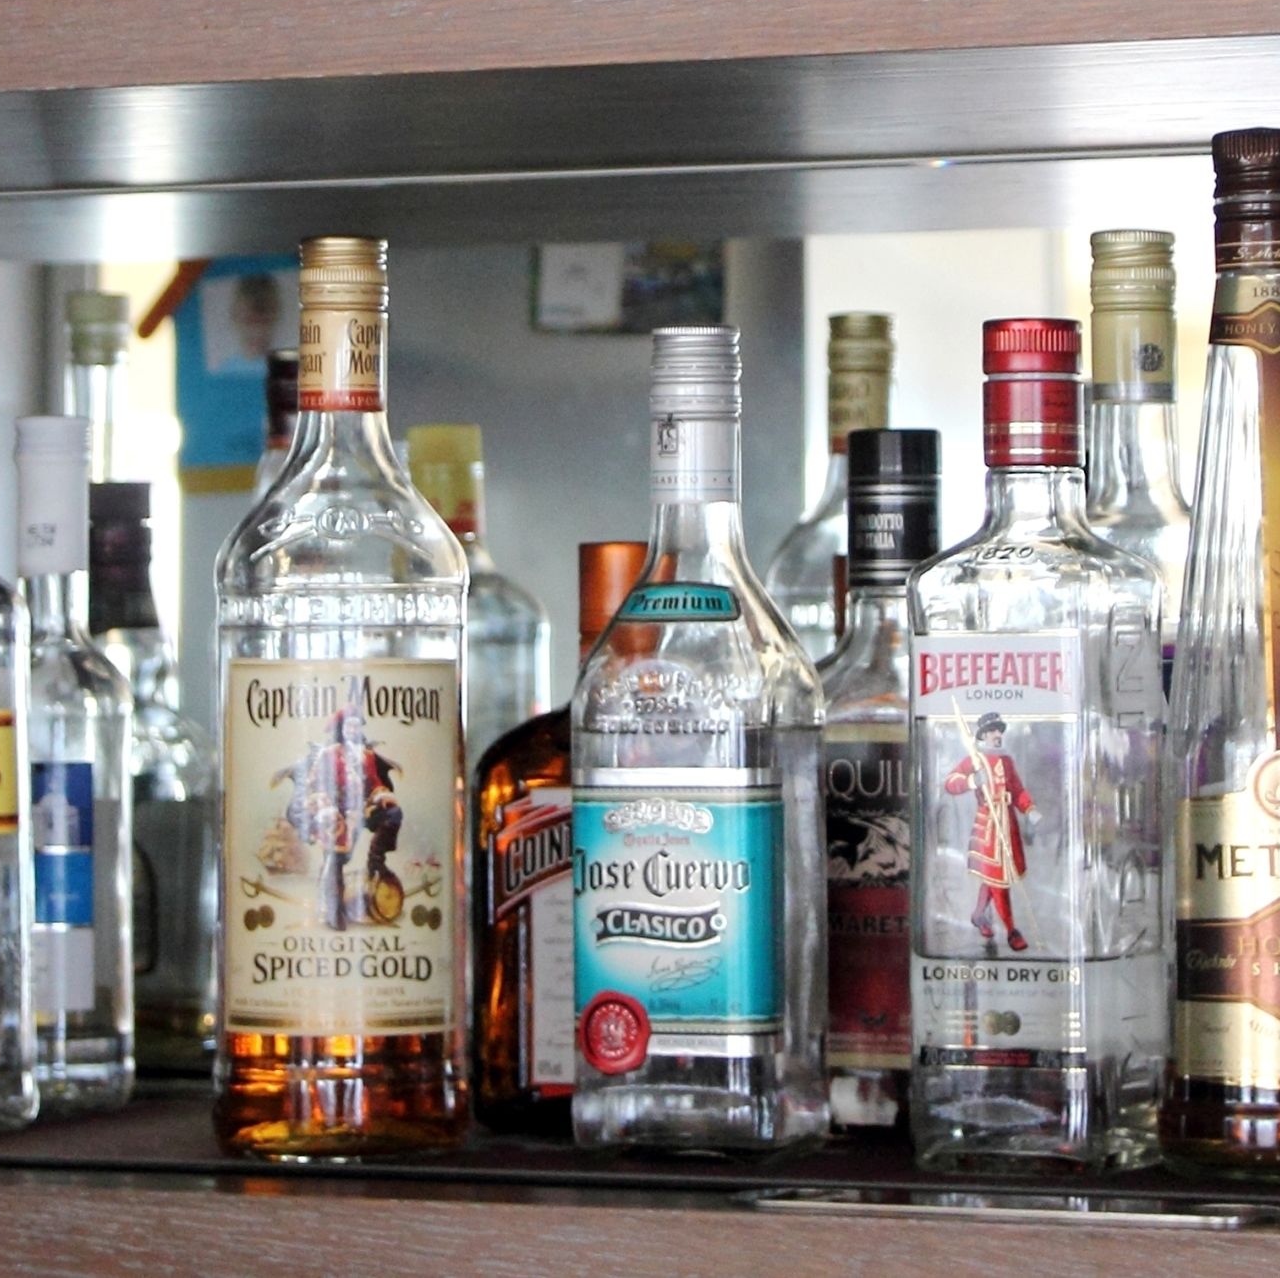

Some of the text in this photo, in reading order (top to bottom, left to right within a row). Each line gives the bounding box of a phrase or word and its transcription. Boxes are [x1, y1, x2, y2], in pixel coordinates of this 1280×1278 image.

[1225, 322, 1277, 336] HONEY
[631, 593, 724, 613] Premium
[919, 652, 1073, 697] BEEFEATER
[246, 674, 441, 729] Captain Morgan
[966, 688, 1024, 701] LONDON
[573, 848, 751, 897] Jose Cuervo
[605, 909, 707, 940] CLASICO
[282, 935, 407, 953] ORIGINAL
[252, 952, 433, 985] SPICED GOLD
[922, 965, 1080, 986] LONDON DRY GIN
